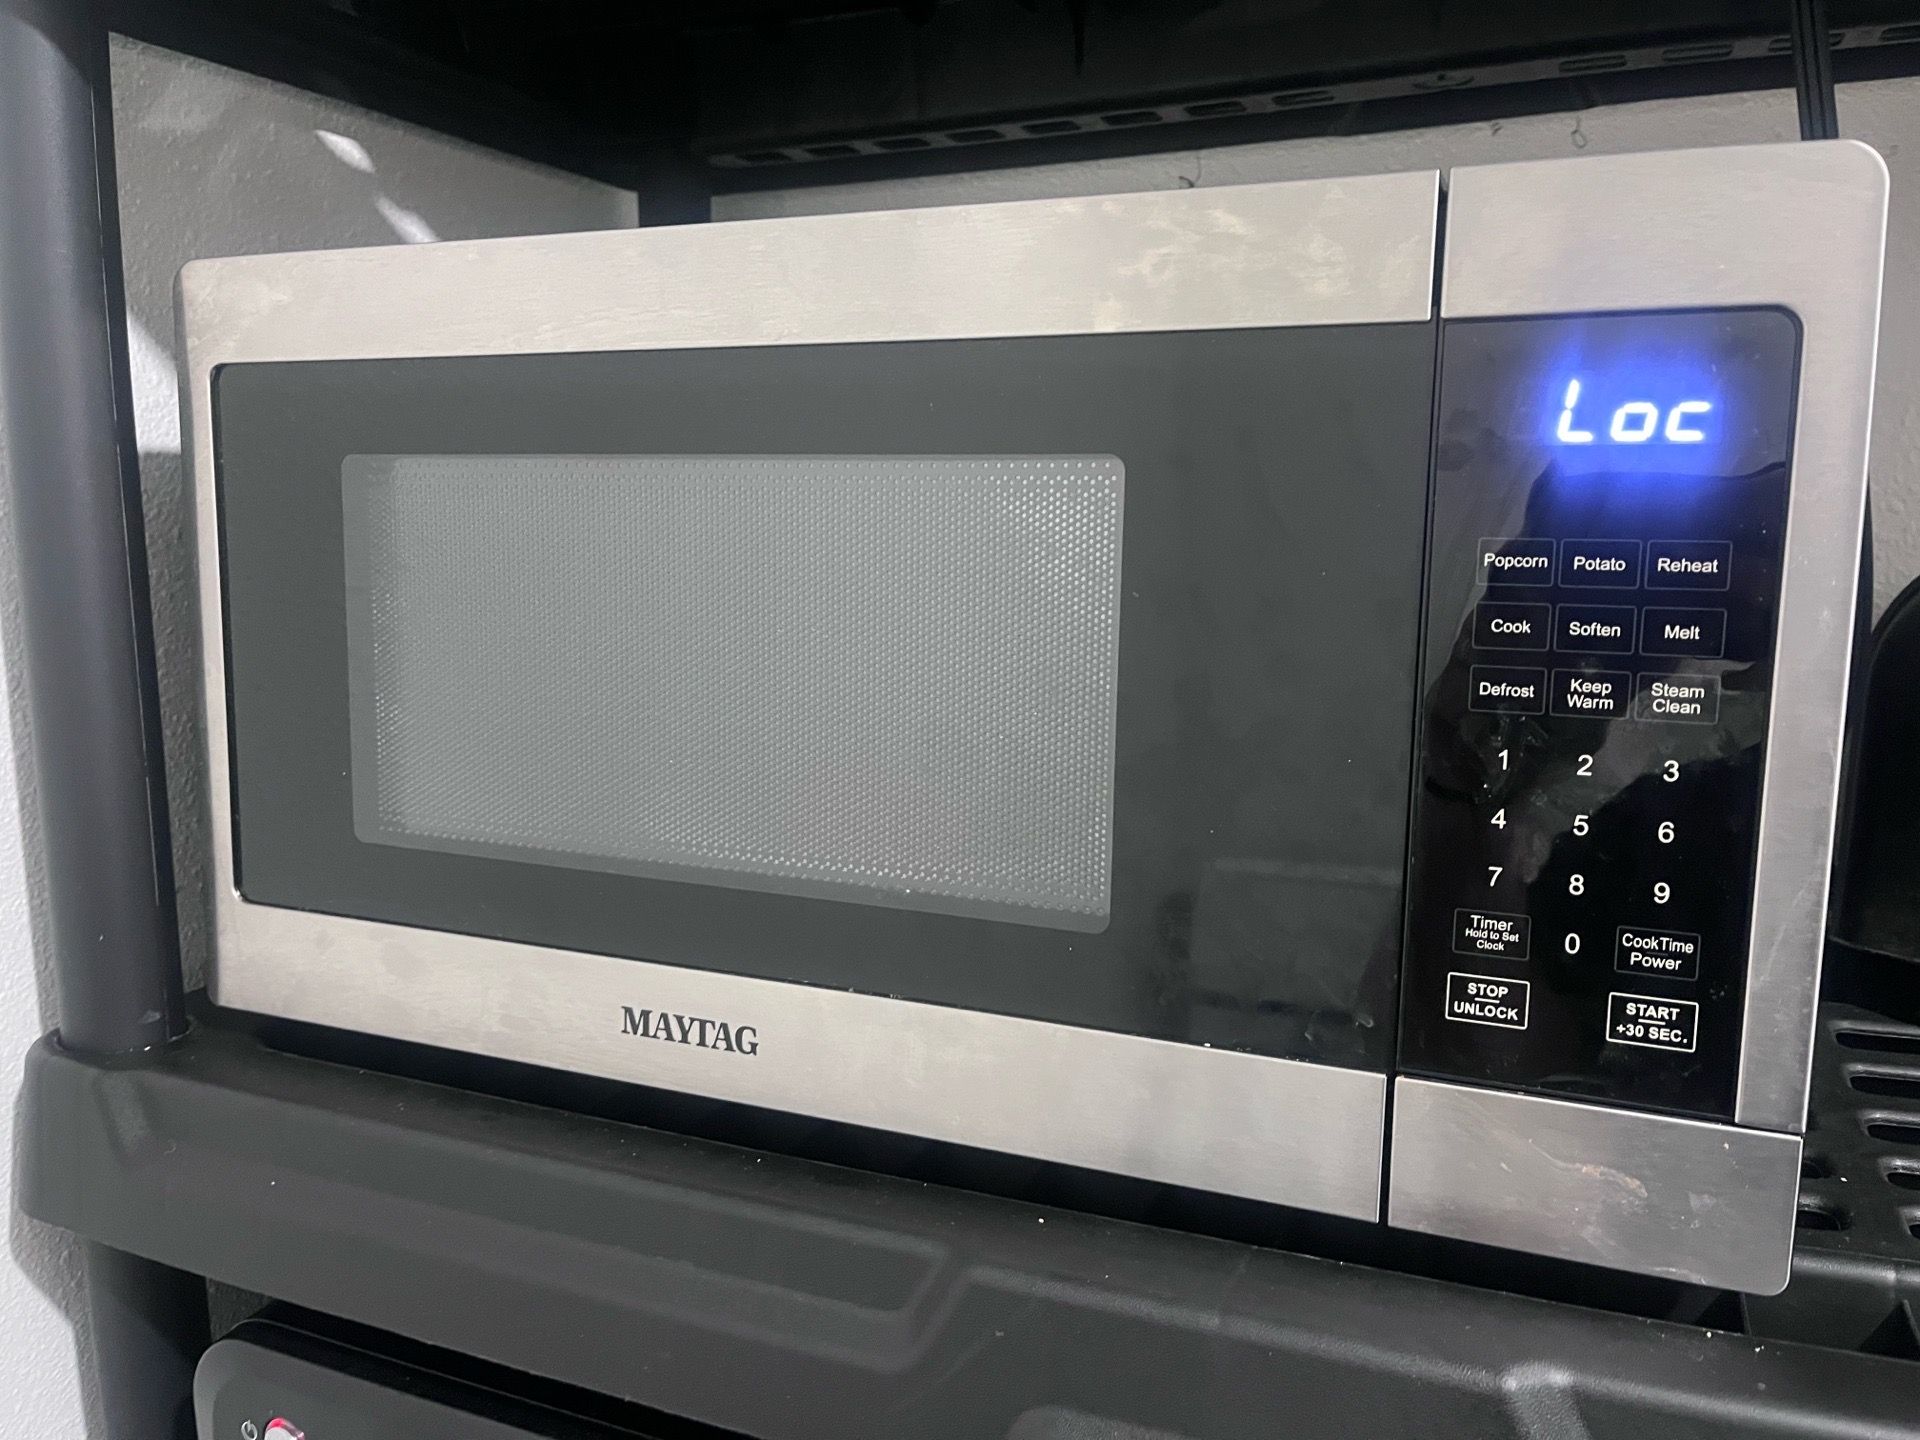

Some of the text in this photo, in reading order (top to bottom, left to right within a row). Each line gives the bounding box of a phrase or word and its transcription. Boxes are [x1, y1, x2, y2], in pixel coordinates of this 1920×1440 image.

[1483, 552, 1549, 570] Popcorn
[1573, 556, 1627, 572] Potato
[1657, 558, 1719, 574] Reheat
[1490, 619, 1532, 634] Cook
[1568, 622, 1622, 638] Soften
[1663, 625, 1701, 640] Melt
[1479, 682, 1535, 698] Defrost
[1570, 679, 1612, 697] Keep
[1650, 682, 1706, 699] Steam
[1566, 694, 1614, 710] Warm
[1652, 699, 1702, 715] Clean
[1498, 749, 1509, 770] 1
[1576, 755, 1594, 776] 2
[1662, 760, 1680, 782] 3
[1490, 809, 1507, 829] 4
[1572, 815, 1589, 836] 5
[1657, 822, 1675, 843] 6
[1488, 867, 1504, 887] 7
[1568, 874, 1585, 895] 8
[1653, 883, 1671, 904] 9
[1470, 914, 1514, 932] Timer
[1465, 927, 1519, 942] Hold to Set
[1564, 933, 1581, 954] 0
[1476, 940, 1505, 951] Clock
[1630, 952, 1682, 971] Power
[1467, 983, 1509, 998] STOP
[1453, 1001, 1519, 1021] UNLOCK
[1625, 1003, 1680, 1021] START
[621, 1006, 759, 1056] MAYTAG
[1616, 1024, 1688, 1044] +30 SEC.
